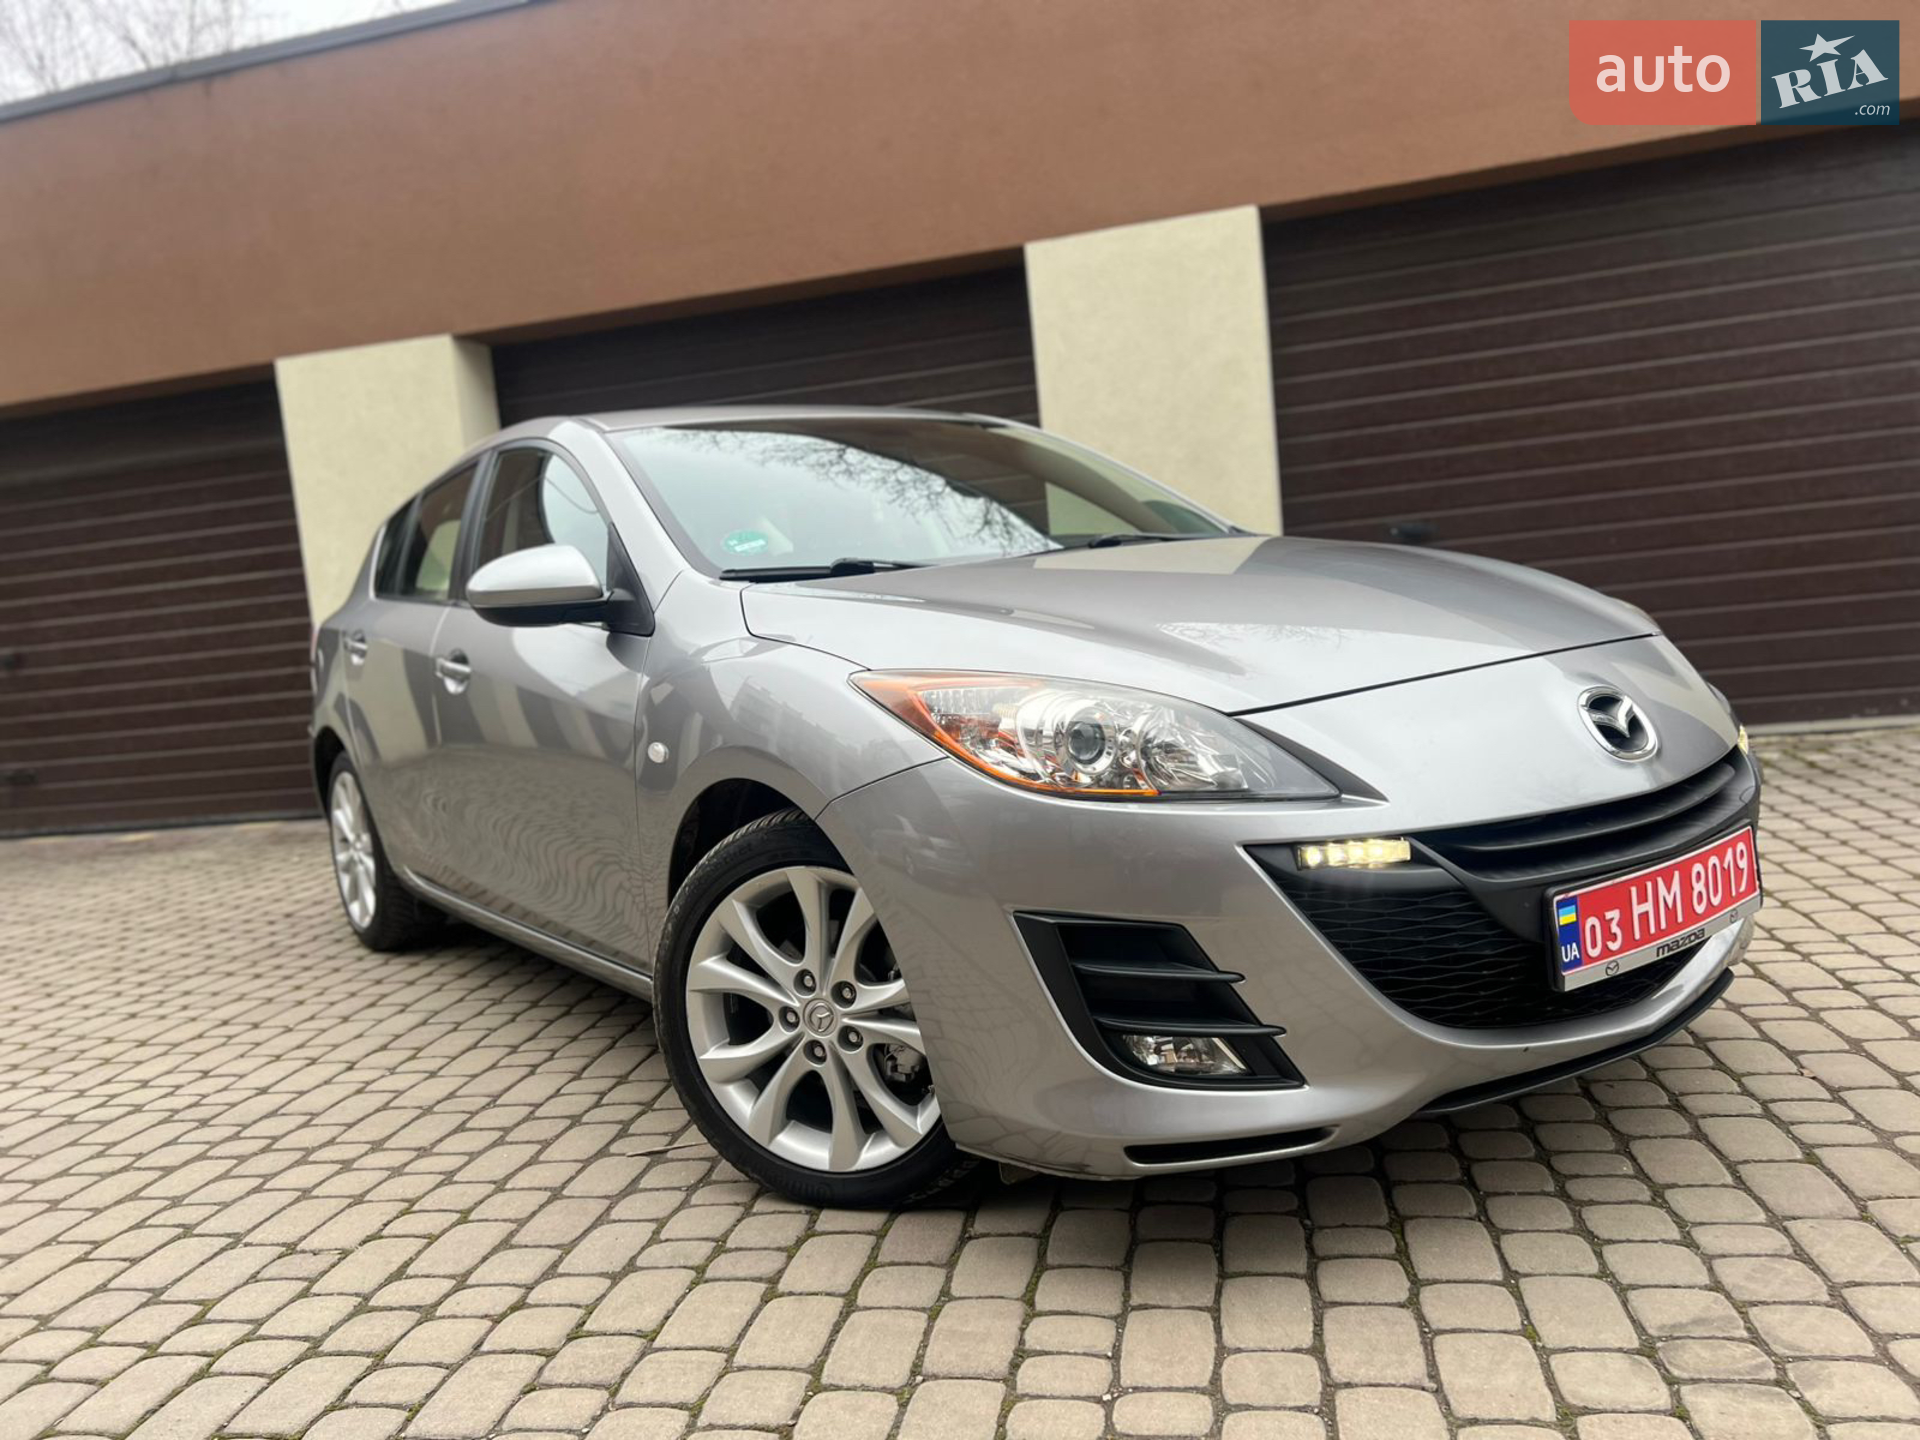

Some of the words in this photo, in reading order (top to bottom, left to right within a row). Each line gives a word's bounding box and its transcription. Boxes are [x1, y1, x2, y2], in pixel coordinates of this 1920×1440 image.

[1584, 909, 1623, 958] 03
[1630, 870, 1684, 941] HM
[1691, 841, 1748, 915] 8019
[1561, 942, 1580, 963] UA
